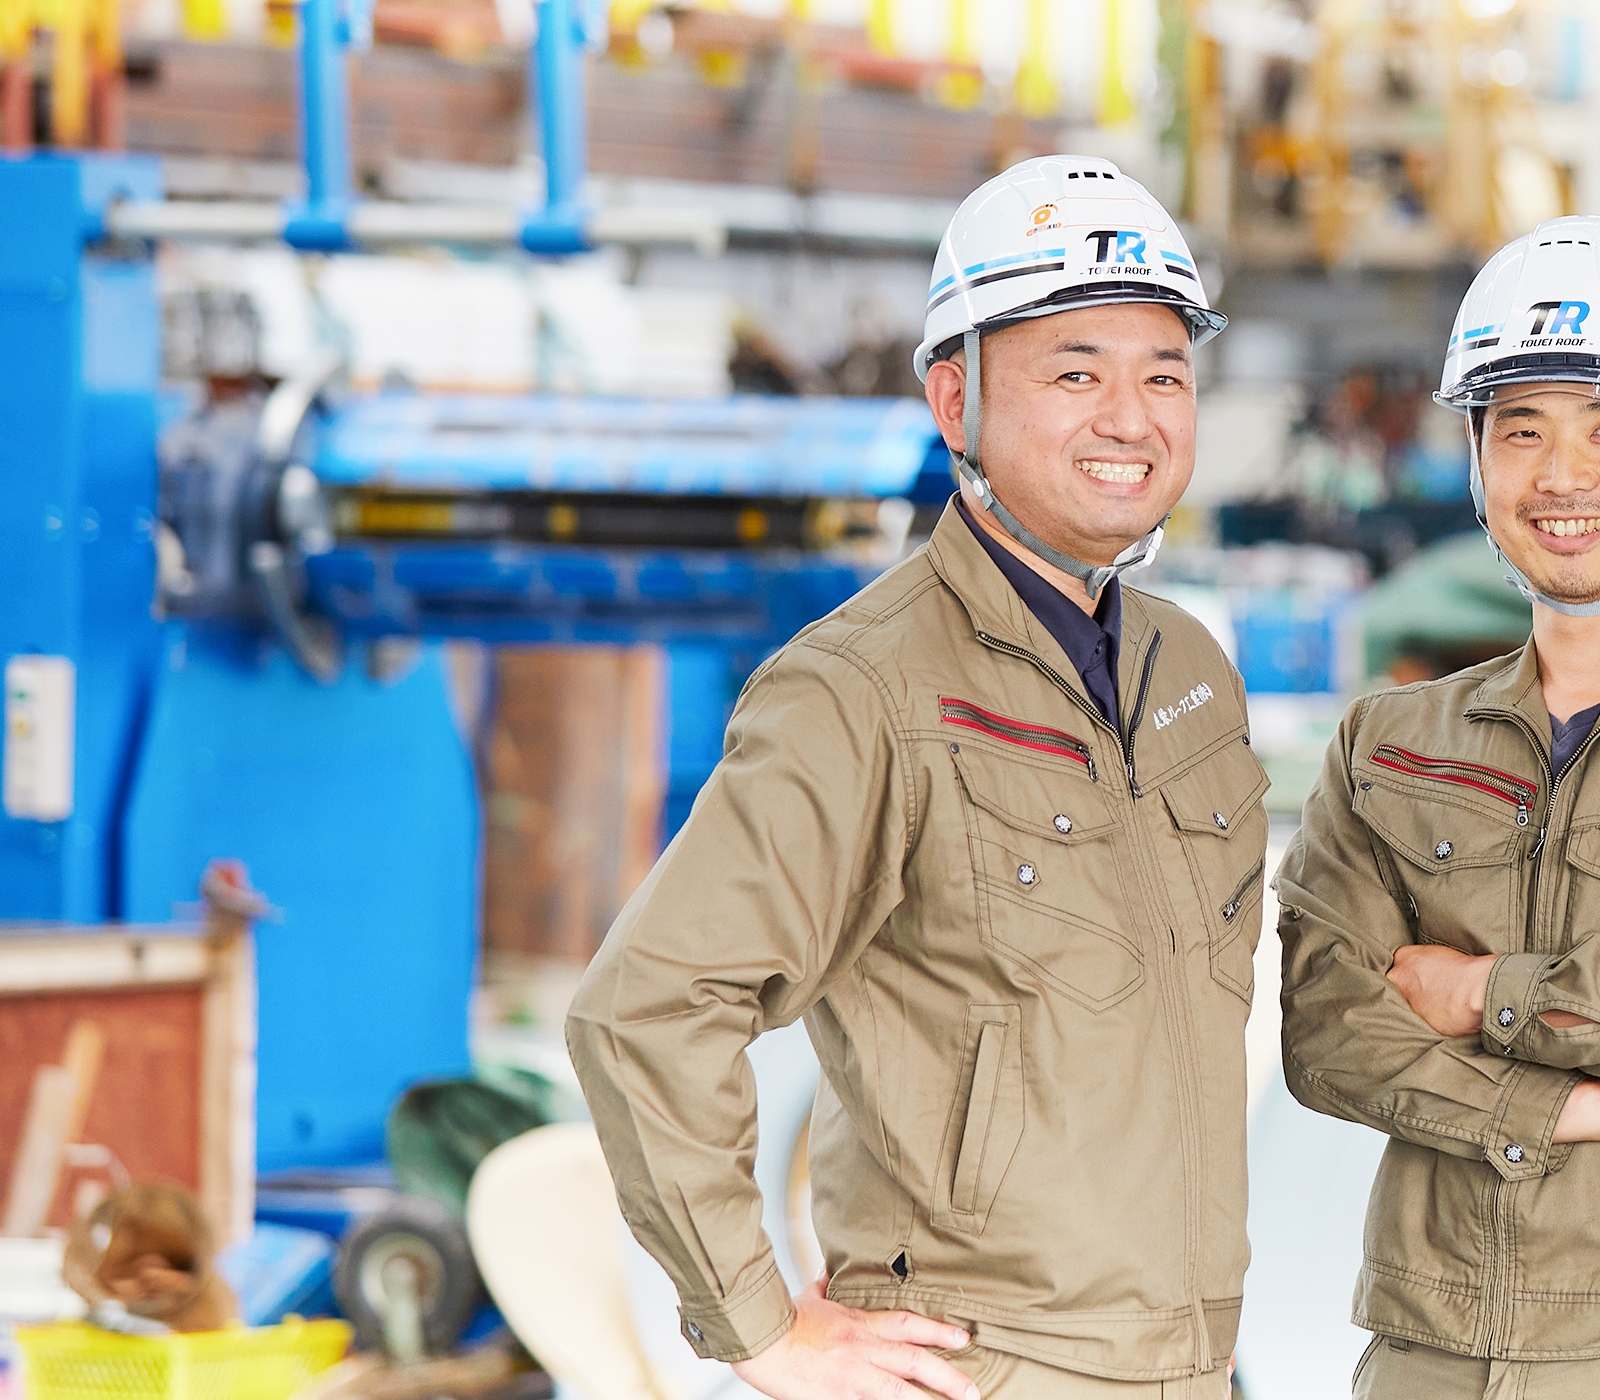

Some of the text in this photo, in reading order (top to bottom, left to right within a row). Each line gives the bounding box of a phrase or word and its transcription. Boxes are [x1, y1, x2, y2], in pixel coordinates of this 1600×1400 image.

[1084, 230, 1146, 264] TR
[1124, 266, 1152, 276] ROOF
[1525, 300, 1591, 336] TR
[1519, 337, 1587, 349] TOUEI ROOF
